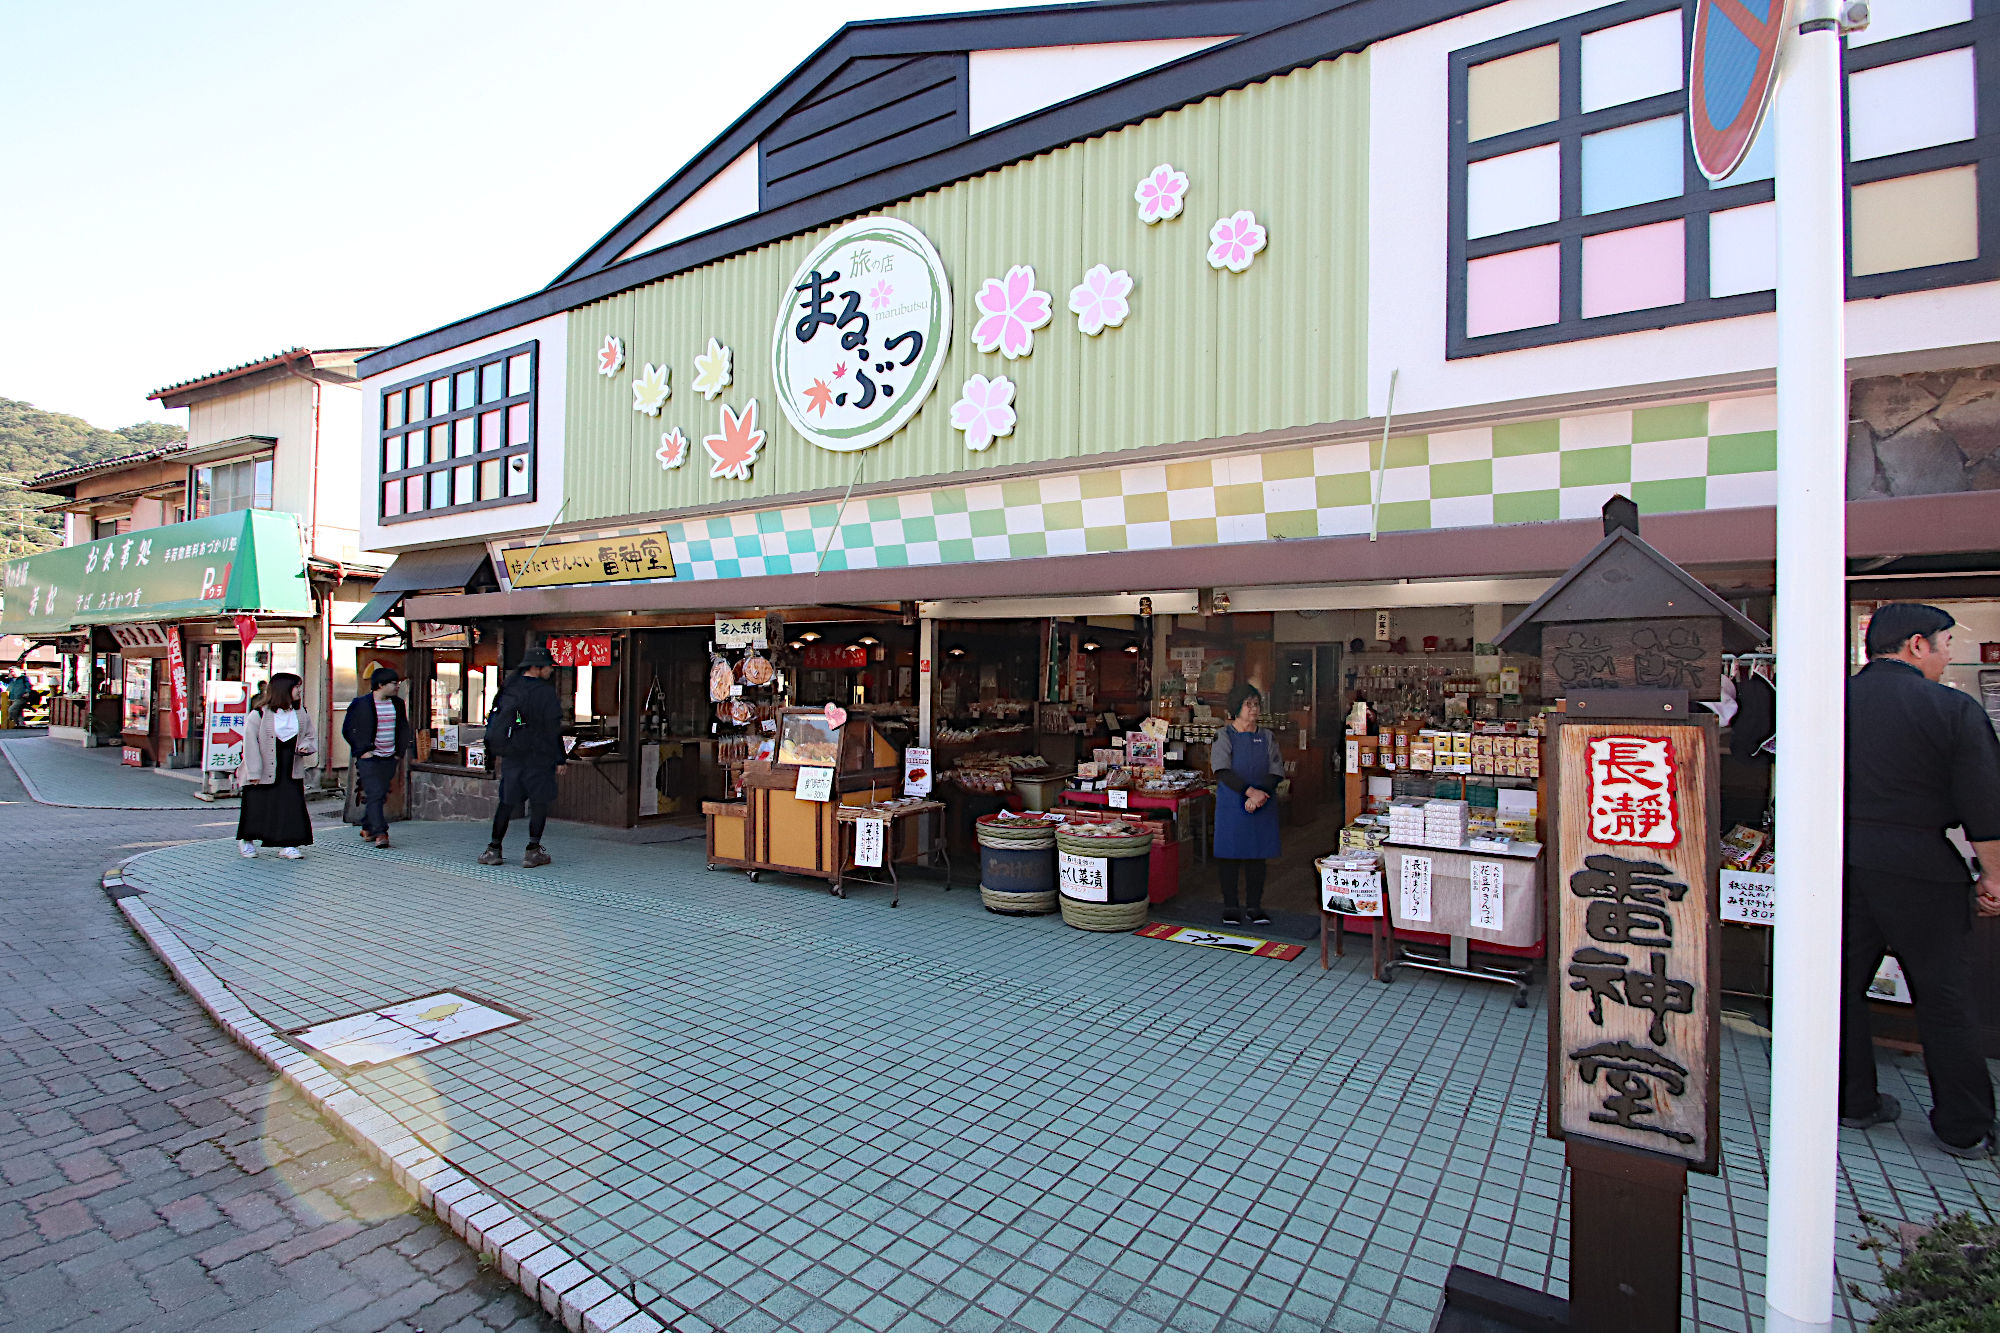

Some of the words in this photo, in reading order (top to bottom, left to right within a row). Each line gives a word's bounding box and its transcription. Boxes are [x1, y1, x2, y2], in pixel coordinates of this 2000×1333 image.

[850, 248, 895, 278] 旅の店
[875, 301, 929, 321] marubutsu
[795, 270, 924, 410] まるぶつ
[86, 538, 153, 575] お食事処
[598, 538, 668, 575] 雷神堂
[200, 567, 216, 600] P
[719, 621, 763, 636] 名入煎餅
[219, 715, 245, 727] 無料
[123, 749, 140, 762] OPEN
[865, 822, 873, 863] みそポテト
[1568, 853, 1697, 1146] 雷神堂
